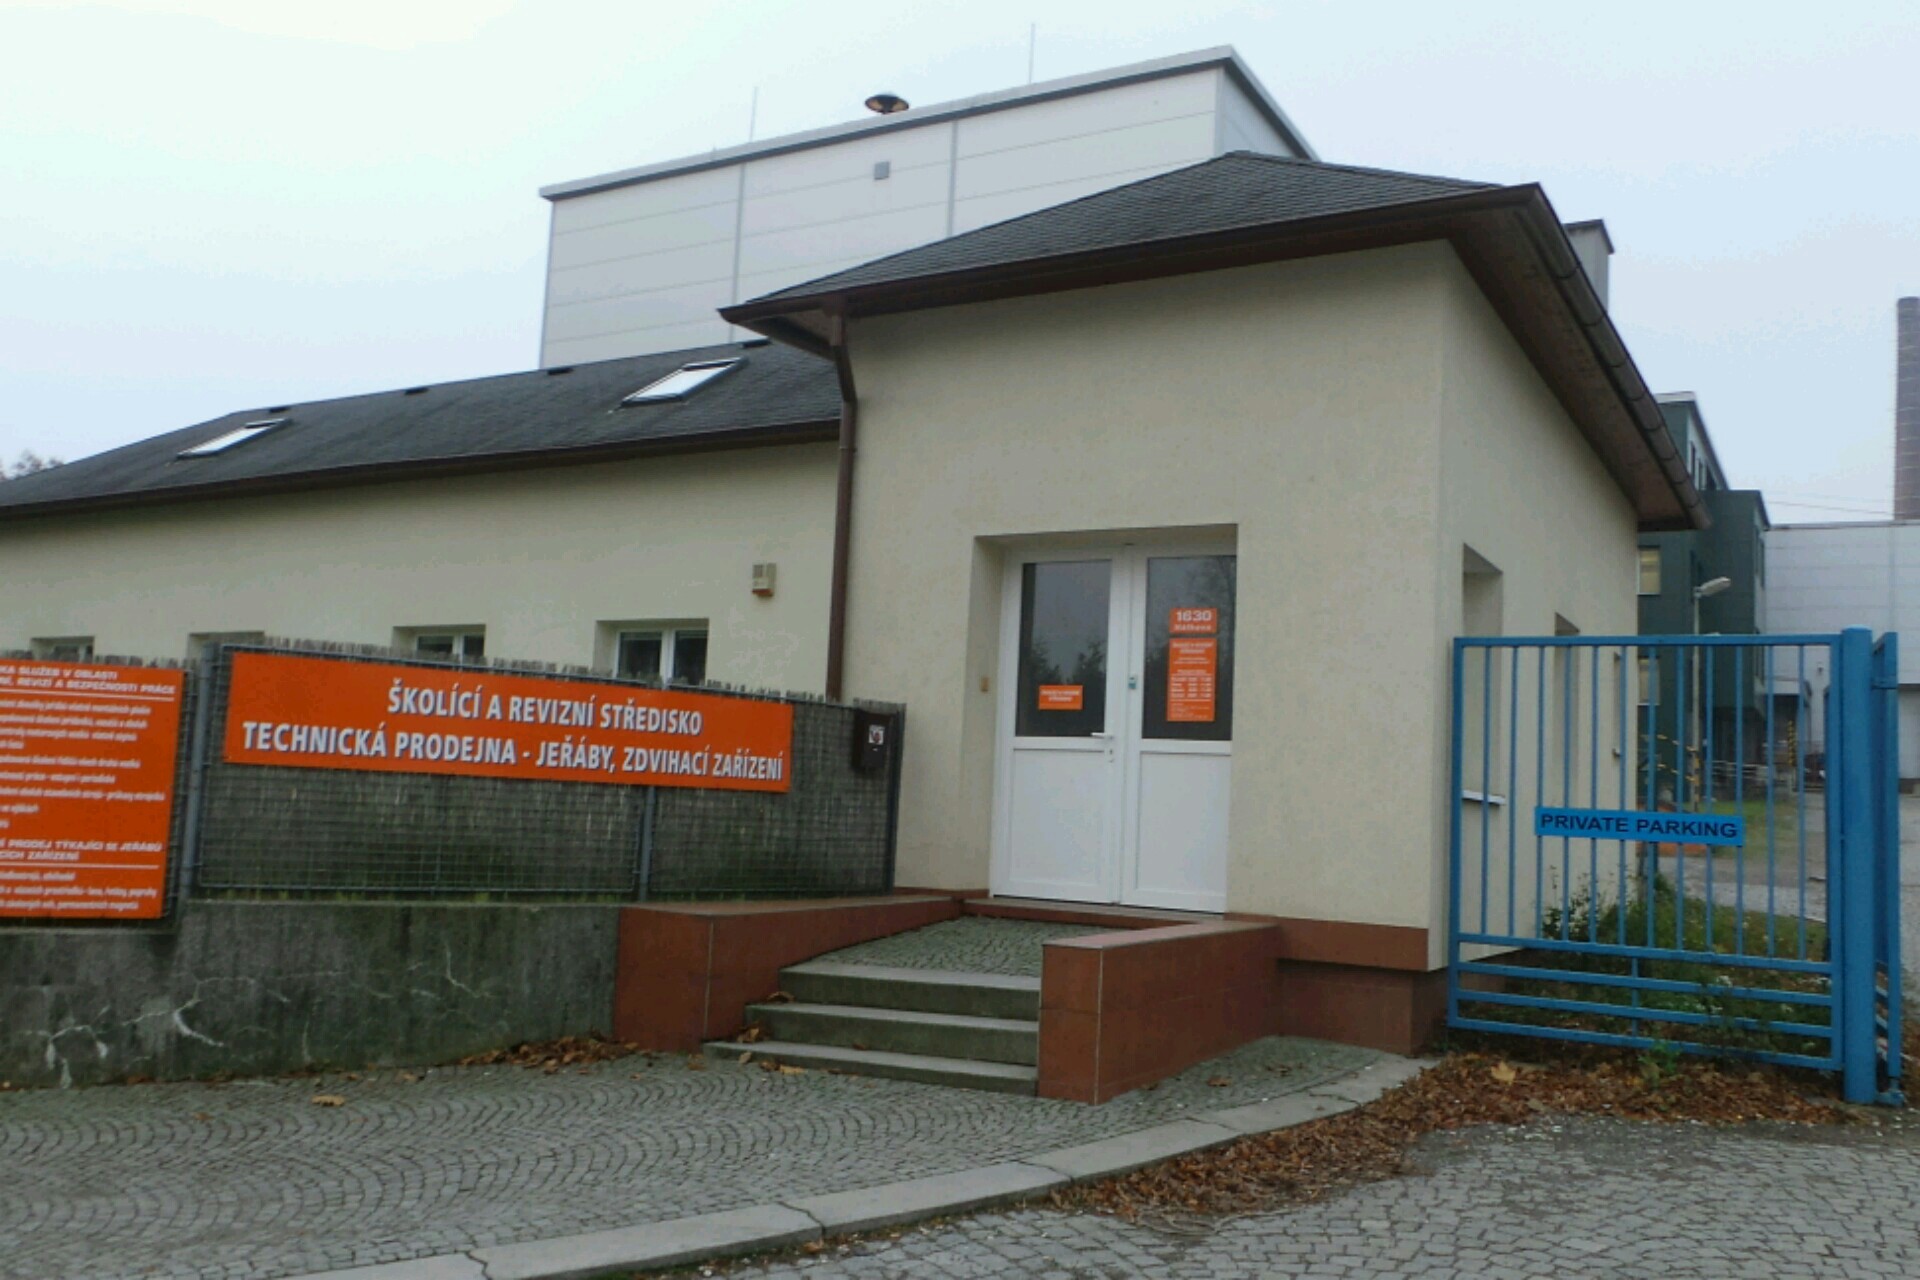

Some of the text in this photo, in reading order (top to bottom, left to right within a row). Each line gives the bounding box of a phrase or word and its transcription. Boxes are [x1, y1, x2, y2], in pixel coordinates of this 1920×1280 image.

[1177, 610, 1212, 622] 1630
[387, 678, 703, 736] ŠKOLÍCÍ A REVIZNÍ STŘEDISKO
[243, 721, 388, 758] TECHNICKÁ
[394, 732, 517, 764] PRODEJNA
[536, 734, 615, 774] JEŘÁBY,
[621, 745, 711, 776] ZDVIHACÍ
[712, 748, 784, 781] ZAŘÍZENÍ
[1541, 813, 1738, 838] PRIVATE PARKING
